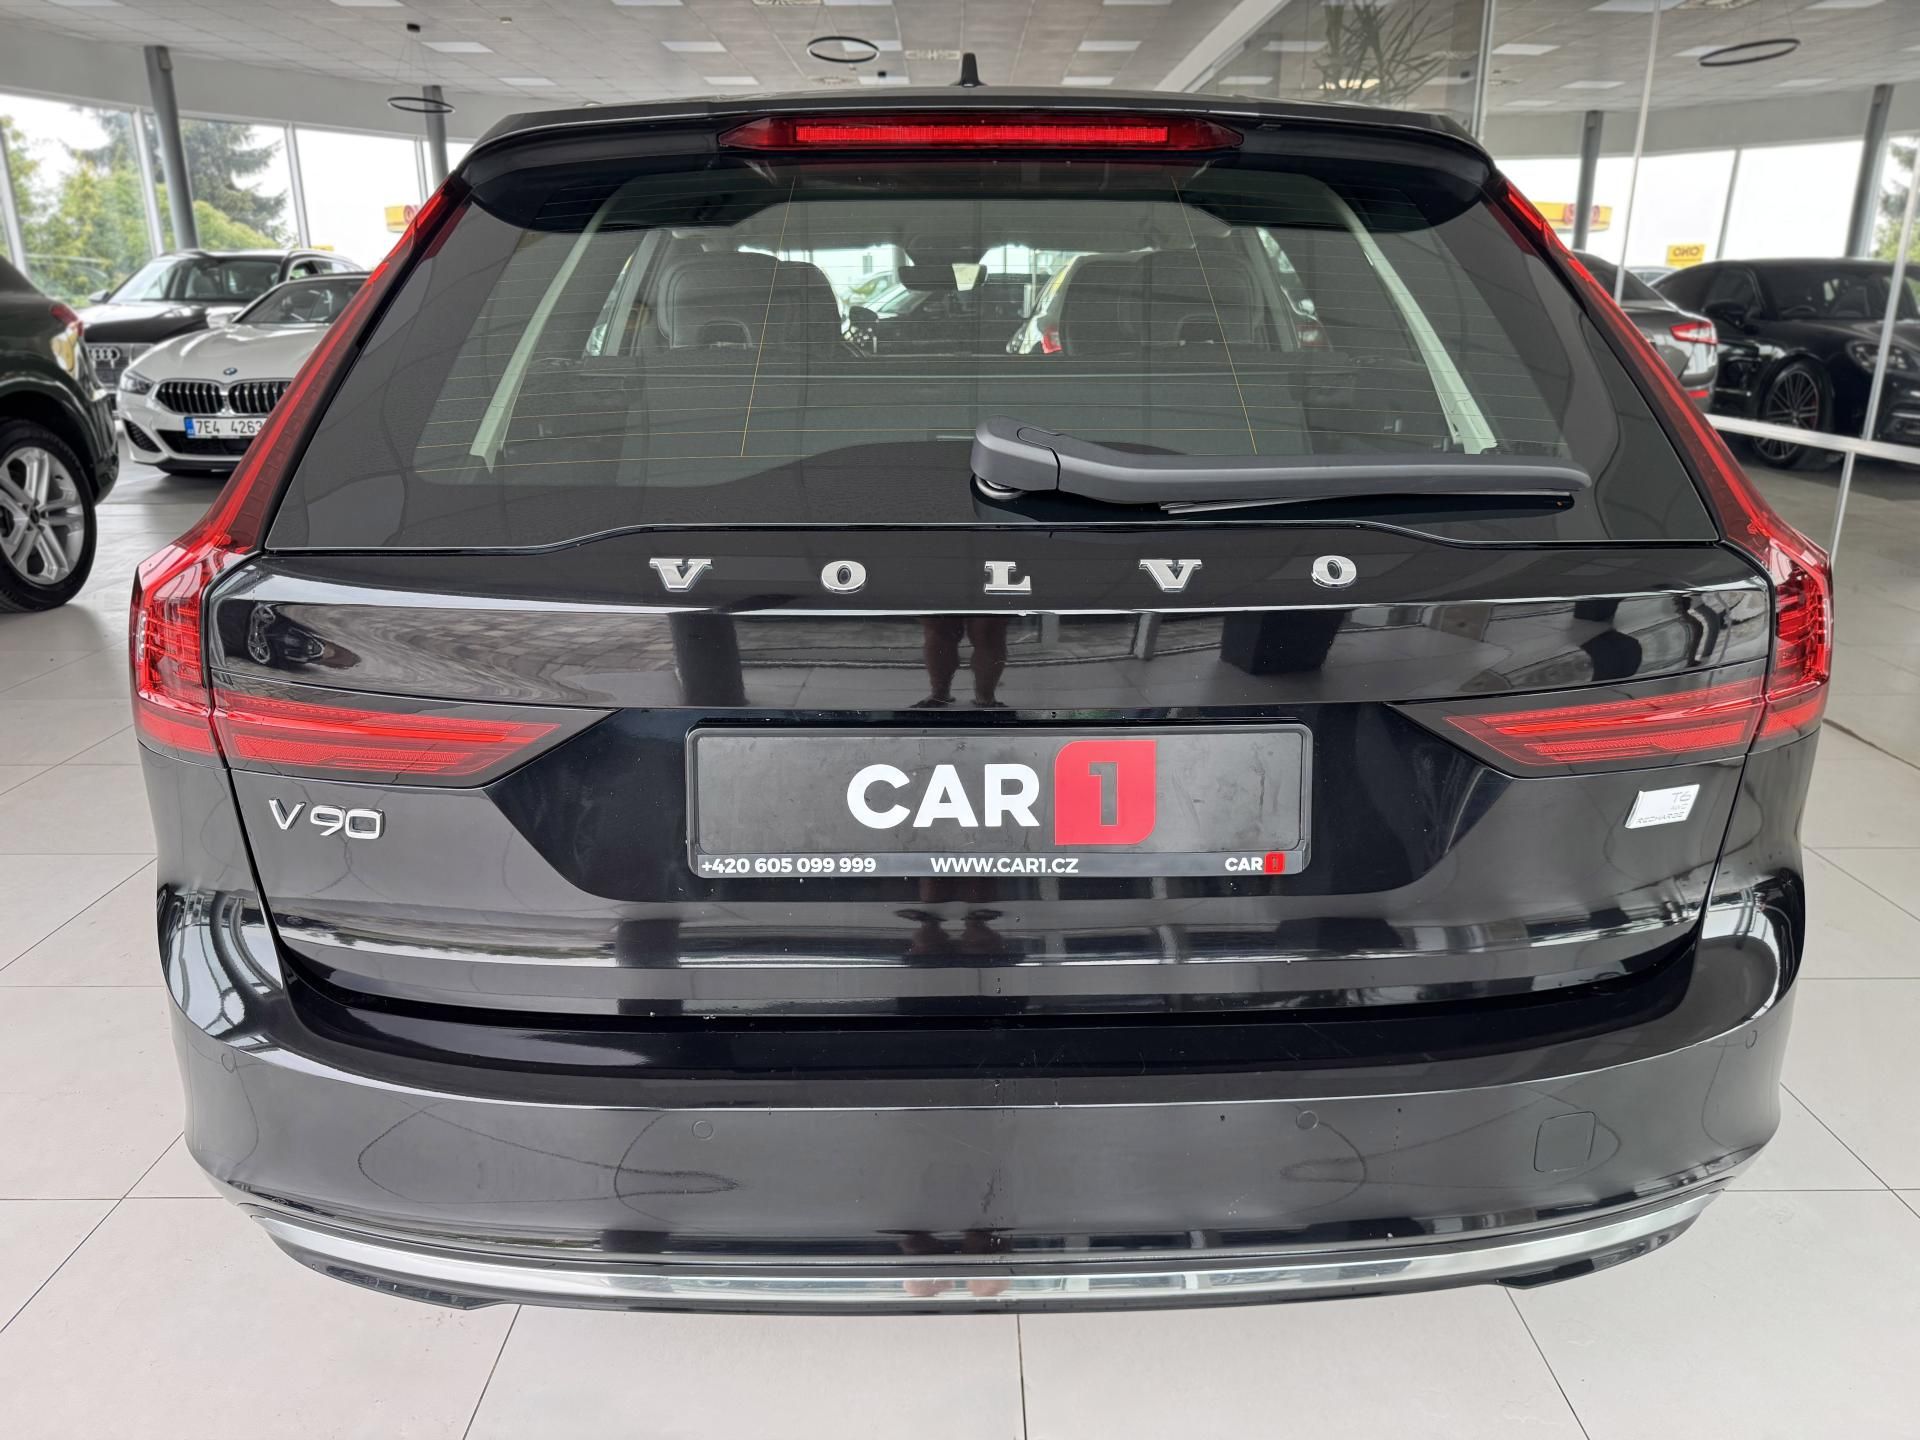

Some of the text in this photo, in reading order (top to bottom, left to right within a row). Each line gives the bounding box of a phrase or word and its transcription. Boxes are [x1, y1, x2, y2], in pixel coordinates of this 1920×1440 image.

[195, 420, 220, 434] 7E4
[649, 555, 1358, 594] VOLVO
[268, 799, 385, 839] V90
[701, 857, 877, 874] +420 605 099 999
[930, 857, 1079, 873] WWW.CAR1.CZ
